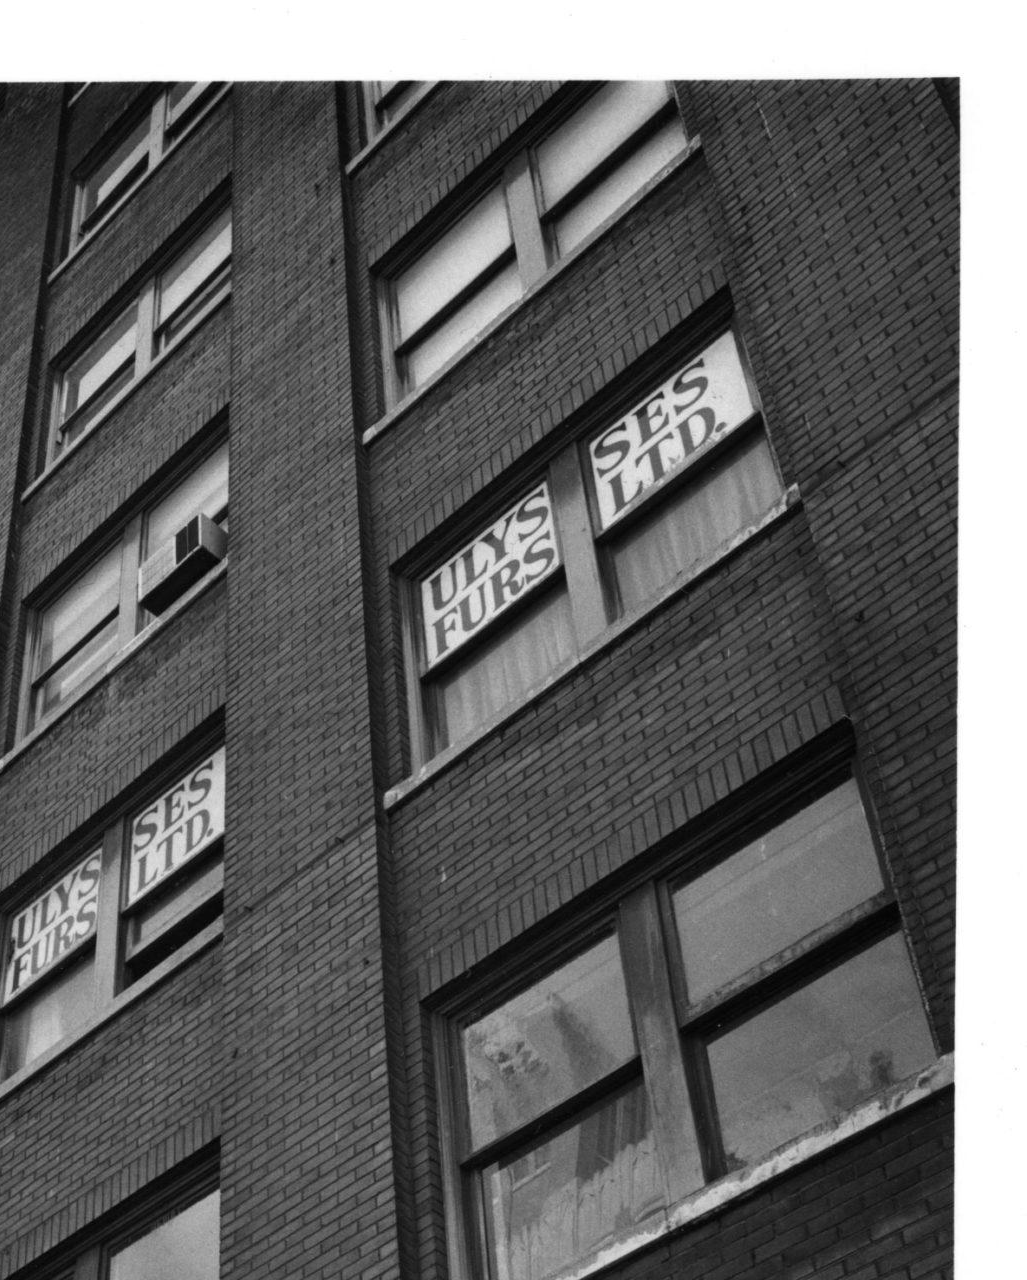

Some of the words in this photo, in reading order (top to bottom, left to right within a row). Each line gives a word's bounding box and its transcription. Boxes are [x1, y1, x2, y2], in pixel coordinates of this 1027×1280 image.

[428, 490, 549, 613] ULYS
[593, 358, 709, 478] SES
[431, 532, 555, 659] FURS
[607, 406, 727, 517] LTD.
[11, 898, 97, 993] FURS
[137, 808, 214, 891] LTD.
[14, 853, 102, 949] ULYS
[133, 759, 213, 854] SES
